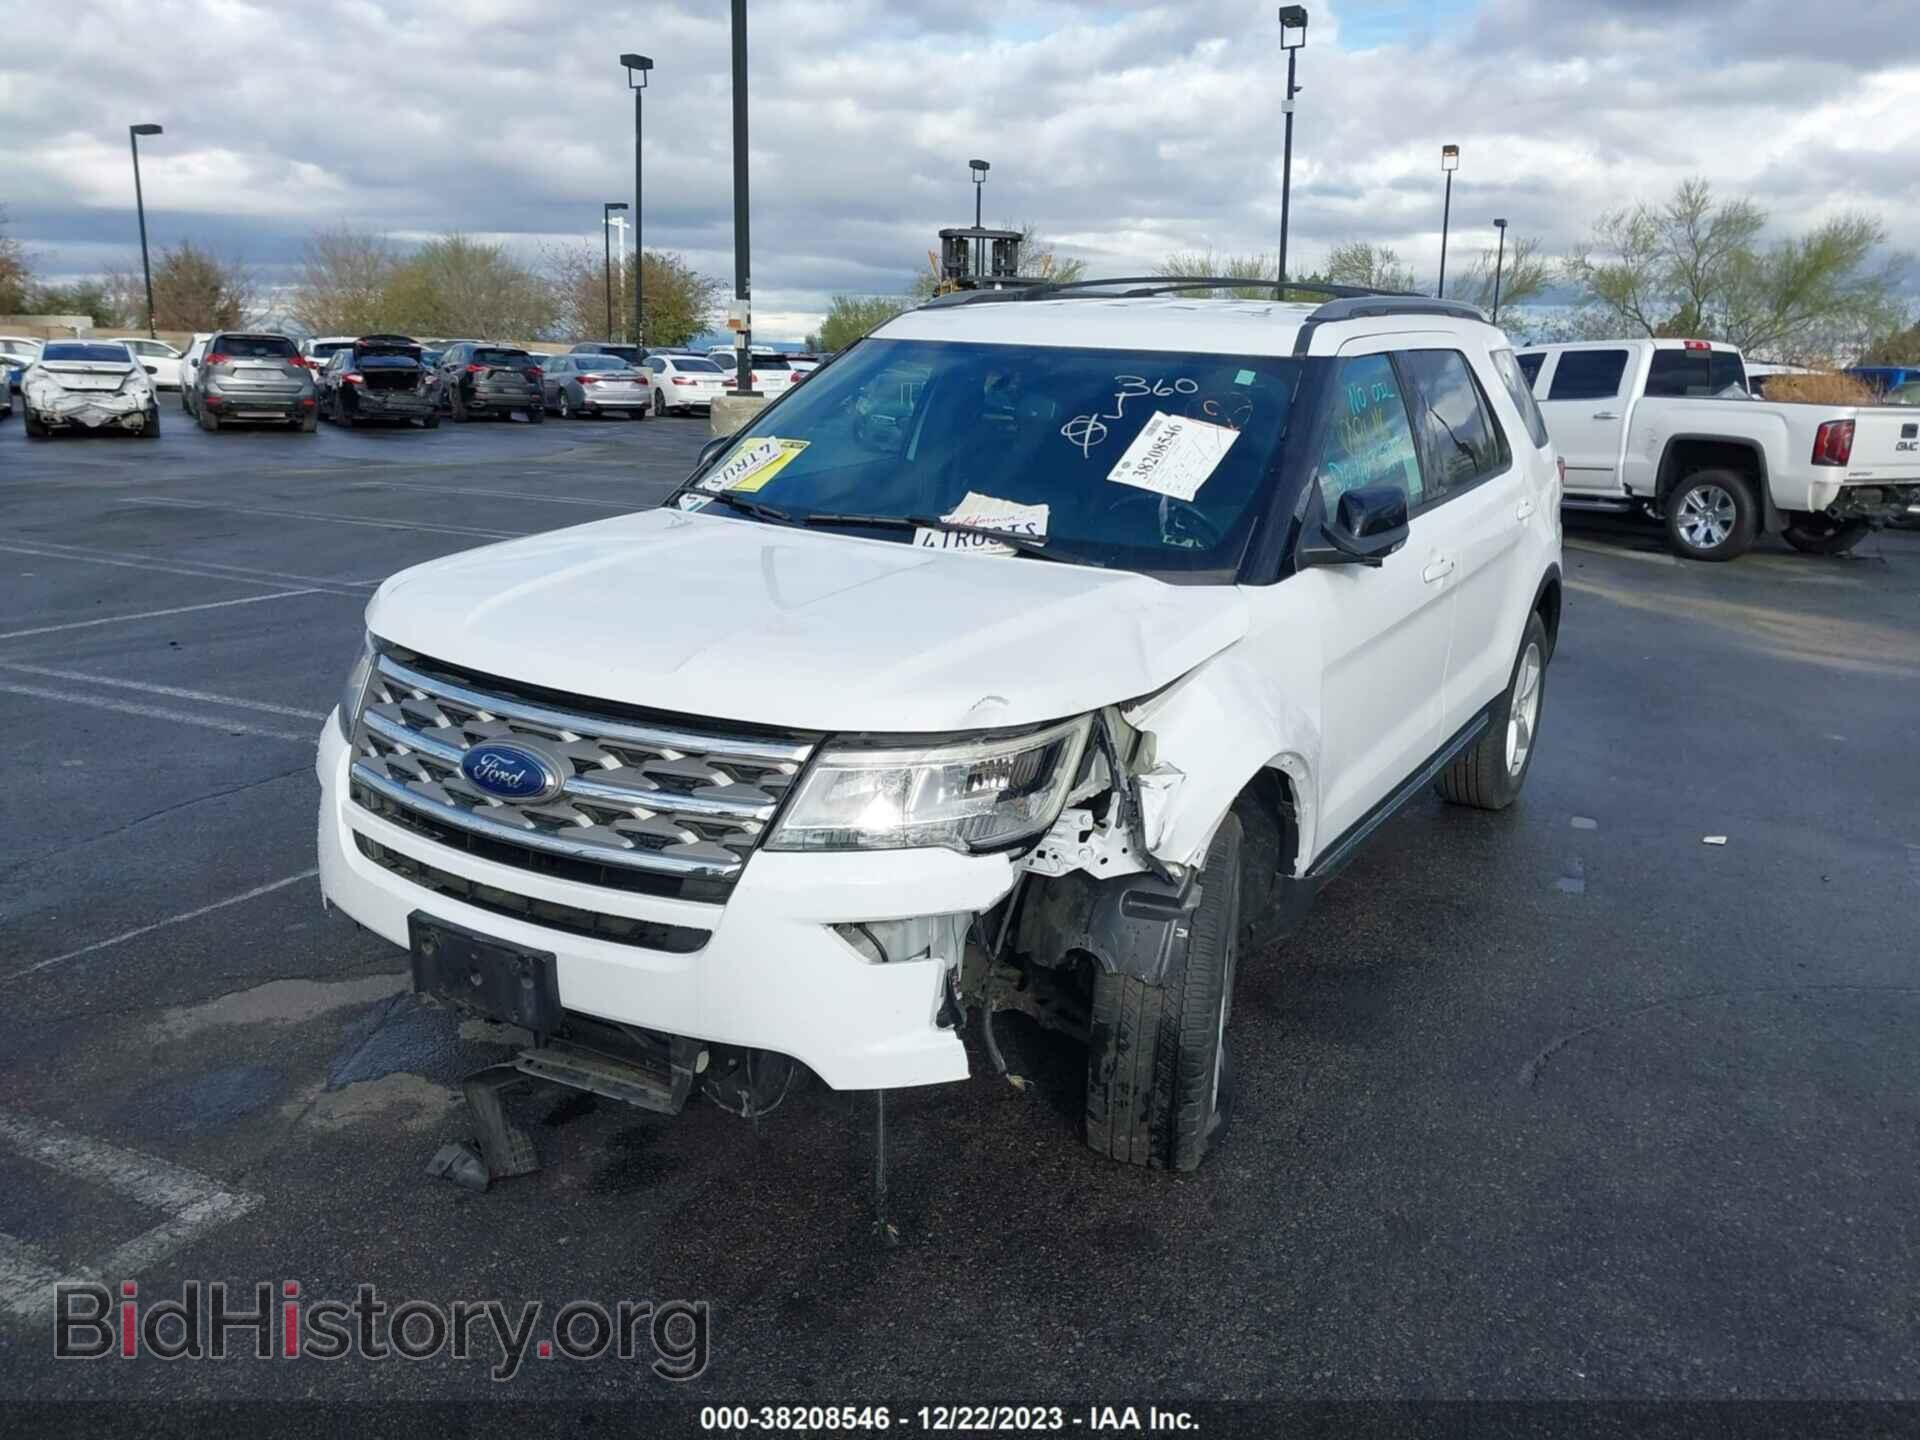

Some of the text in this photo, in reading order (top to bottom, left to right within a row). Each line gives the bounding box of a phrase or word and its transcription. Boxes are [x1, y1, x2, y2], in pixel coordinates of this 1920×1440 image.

[1114, 375, 1199, 396] 360
[1132, 423, 1182, 480] 38208546
[1896, 442, 1919, 451] GMC
[474, 753, 526, 788] Ford
